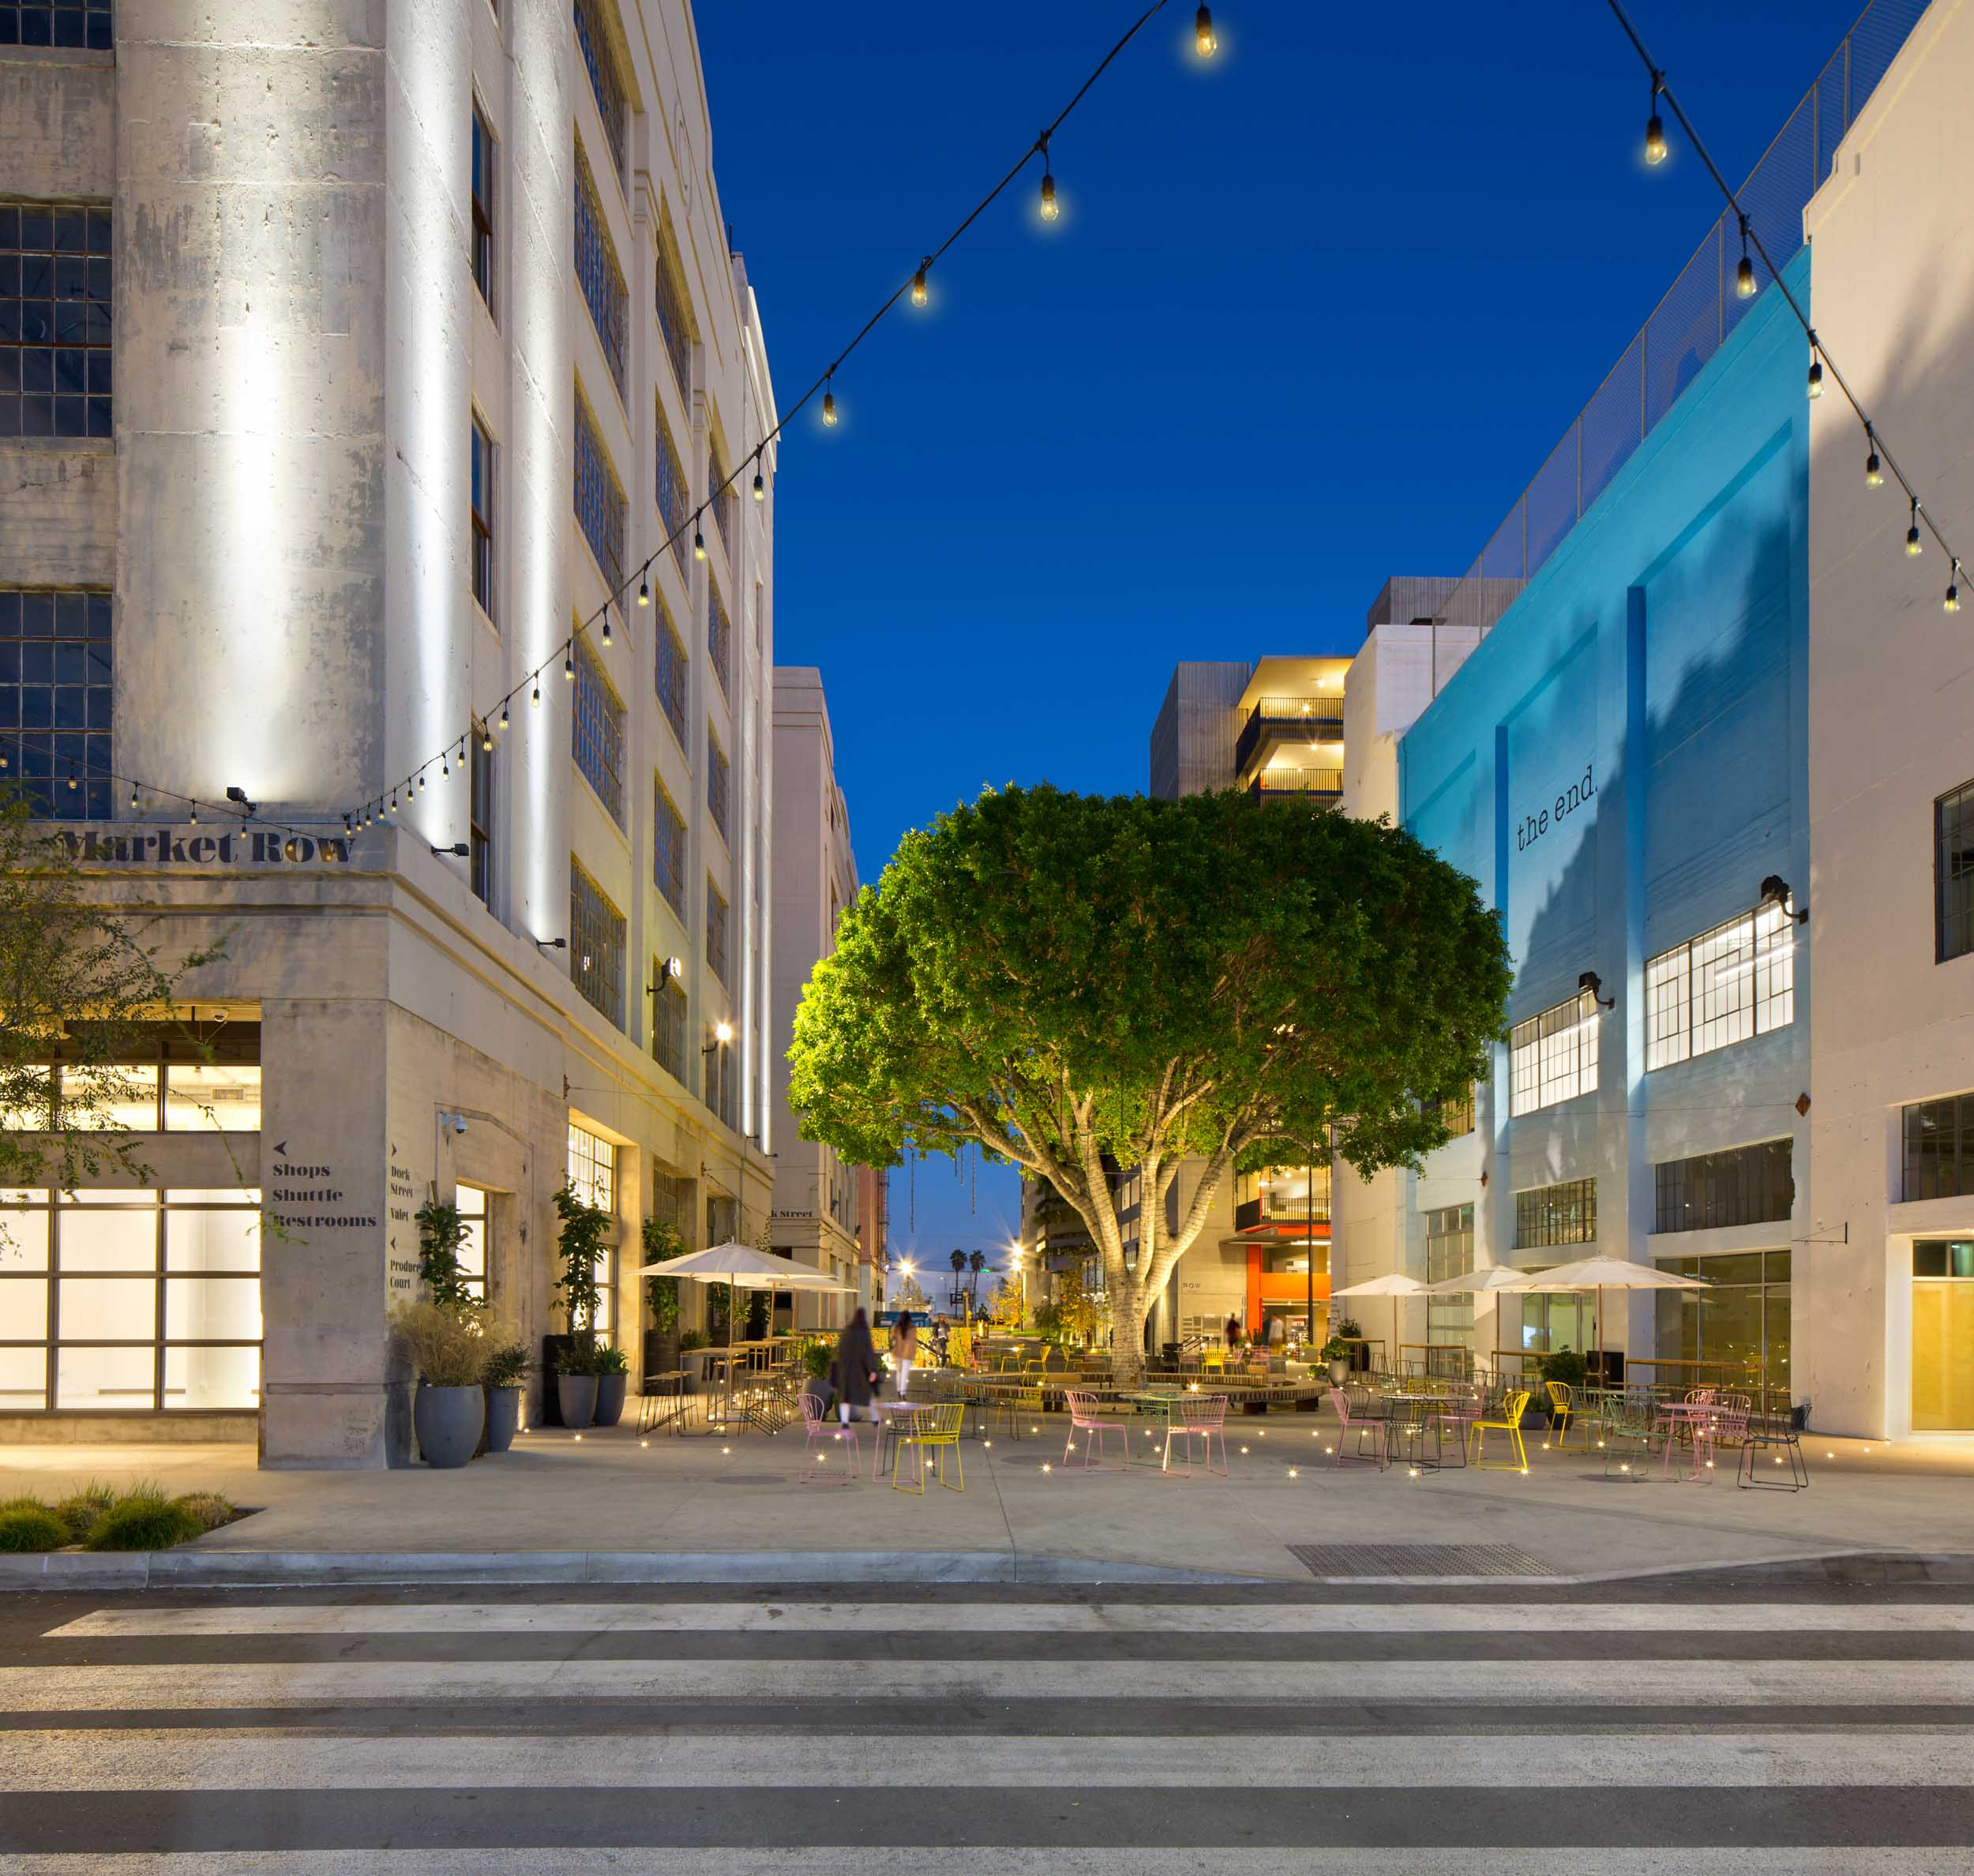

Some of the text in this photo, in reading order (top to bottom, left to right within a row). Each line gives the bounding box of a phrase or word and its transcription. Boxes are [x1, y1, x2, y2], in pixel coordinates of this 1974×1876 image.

[1518, 764, 1598, 851] the end.
[58, 831, 356, 863] Market Row
[272, 1164, 330, 1178] Shops
[392, 1165, 410, 1181] Dock
[272, 1188, 343, 1202] Shuttle
[391, 1183, 413, 1199] Street
[273, 1215, 377, 1227] Restrooms
[391, 1207, 408, 1221] Valet
[390, 1276, 411, 1289] Court
